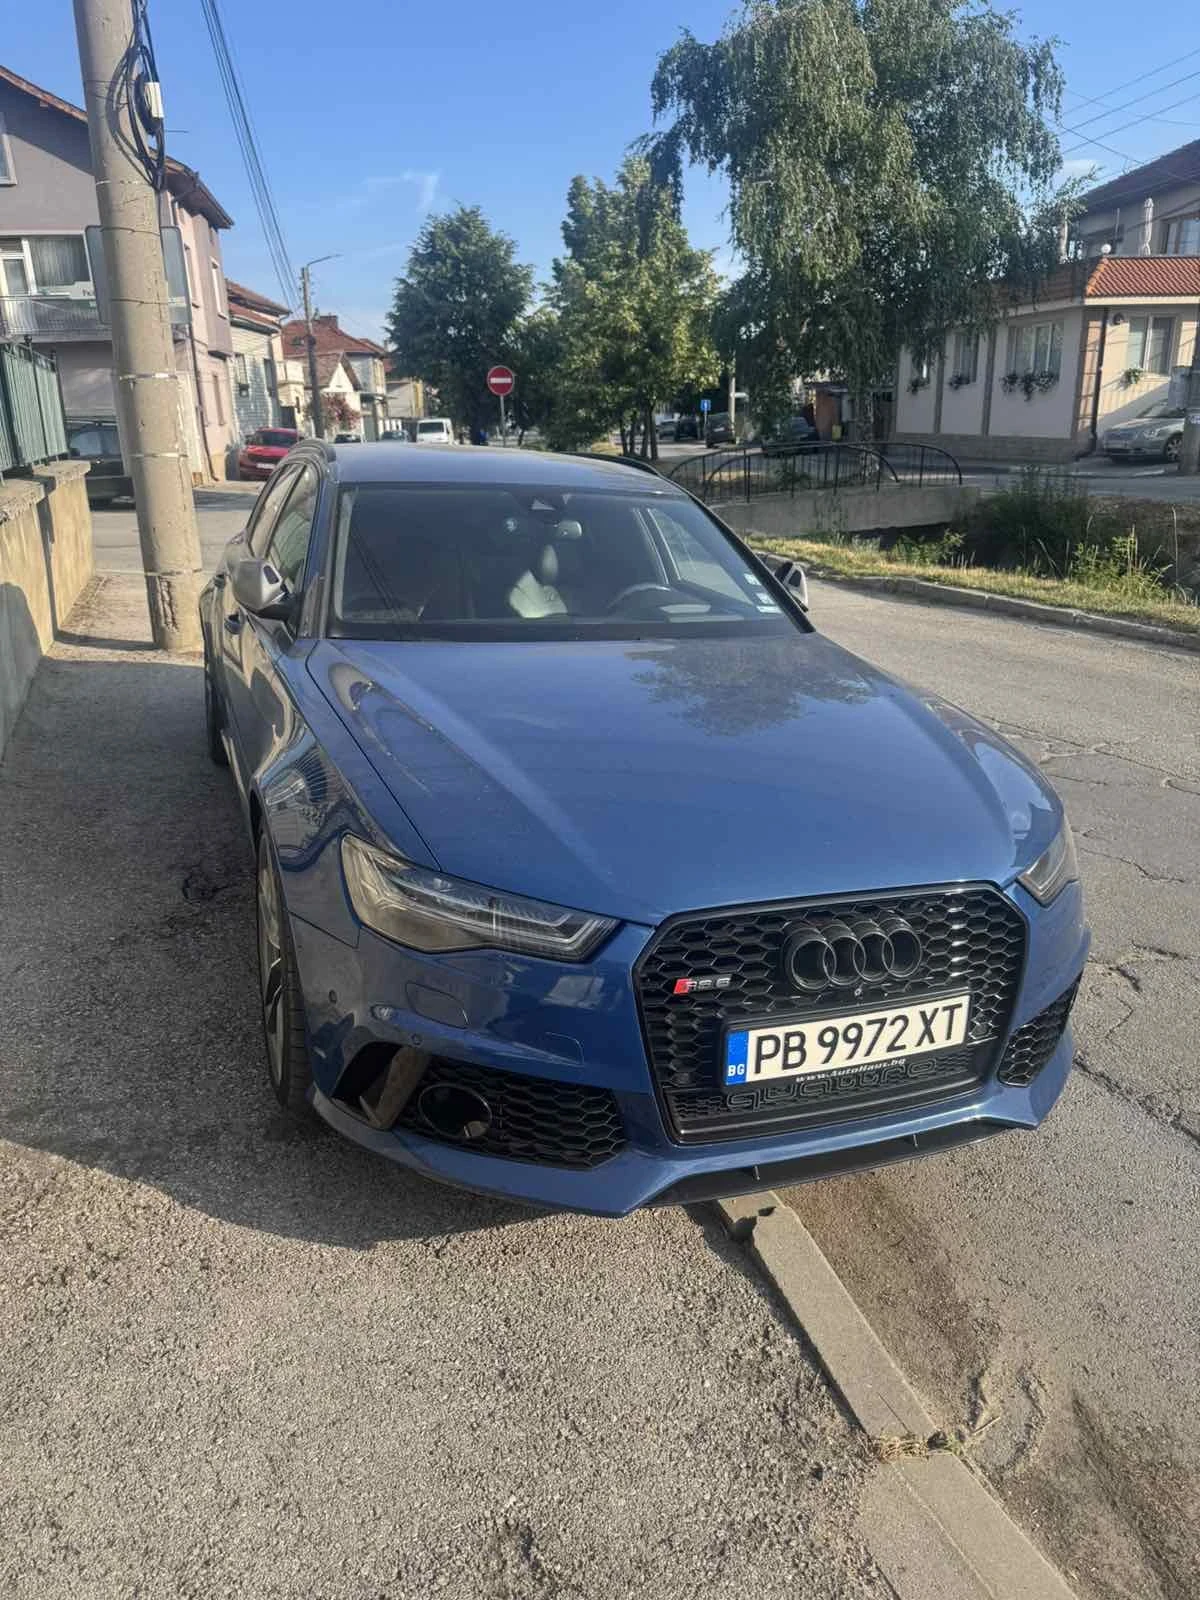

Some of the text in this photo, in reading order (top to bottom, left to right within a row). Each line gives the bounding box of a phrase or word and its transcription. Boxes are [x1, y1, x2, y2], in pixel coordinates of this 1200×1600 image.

[755, 1003, 963, 1074] PB 9972 XT
[727, 1063, 745, 1077] BG
